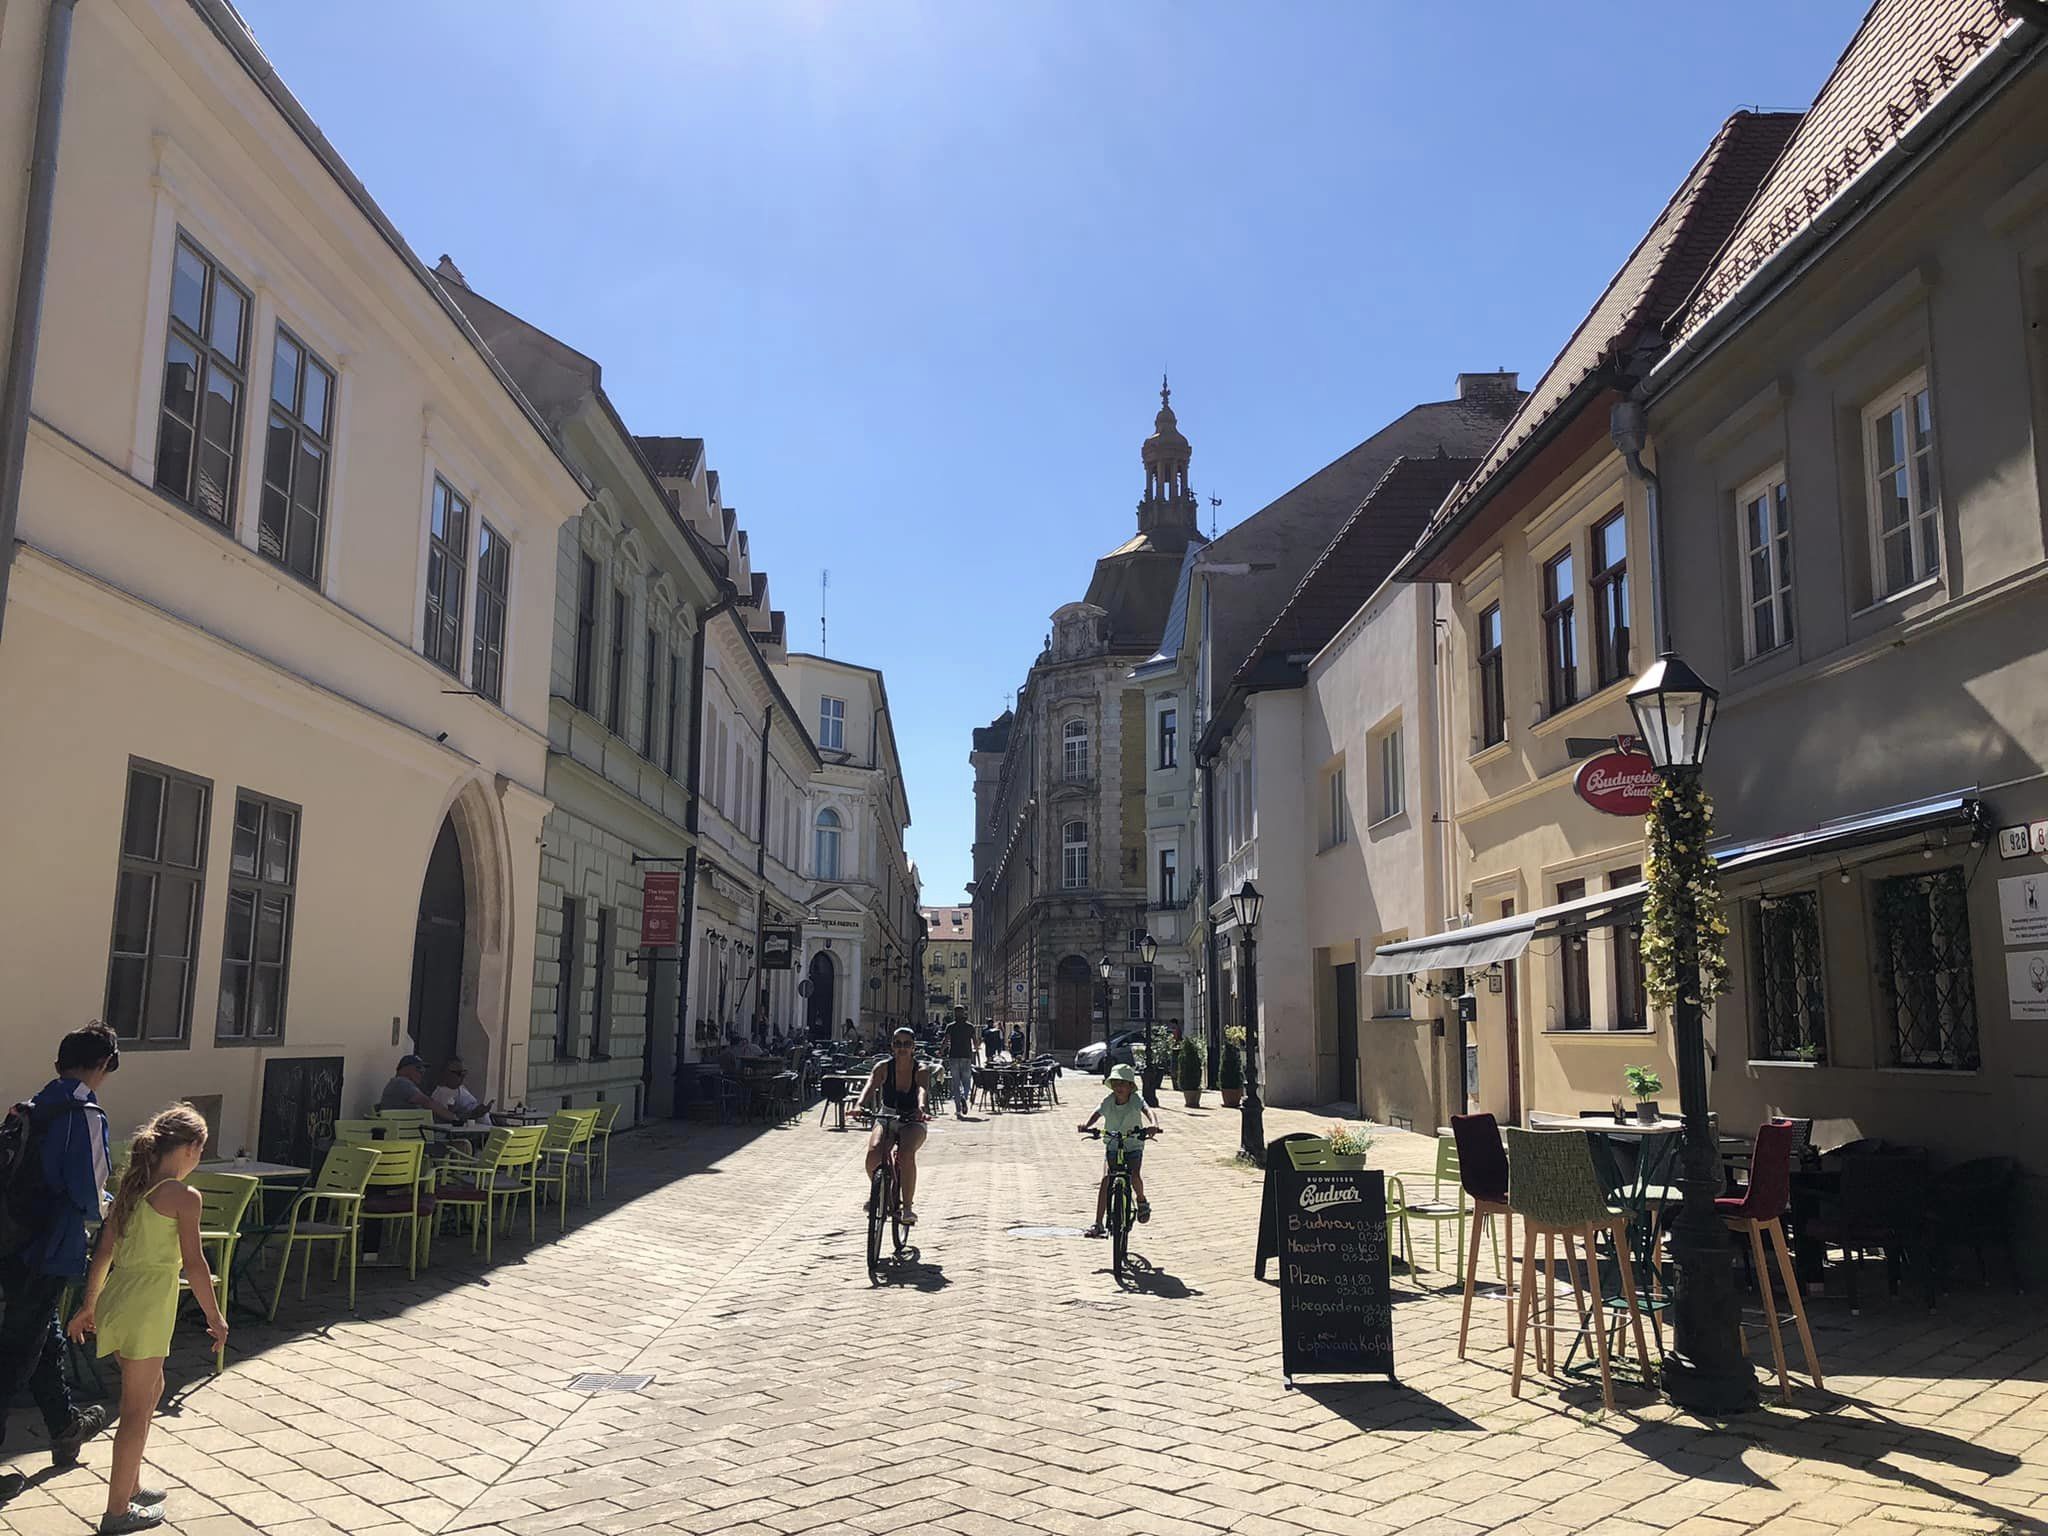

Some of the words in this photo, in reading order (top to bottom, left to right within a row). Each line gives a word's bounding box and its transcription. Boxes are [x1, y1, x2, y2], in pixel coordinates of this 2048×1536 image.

[1586, 769, 1661, 793] Budweise
[2009, 831, 2027, 850] 928
[1299, 1184, 1361, 1210] Budvar
[1288, 1213, 1355, 1231] Budvar
[1287, 1236, 1336, 1254] Maestro
